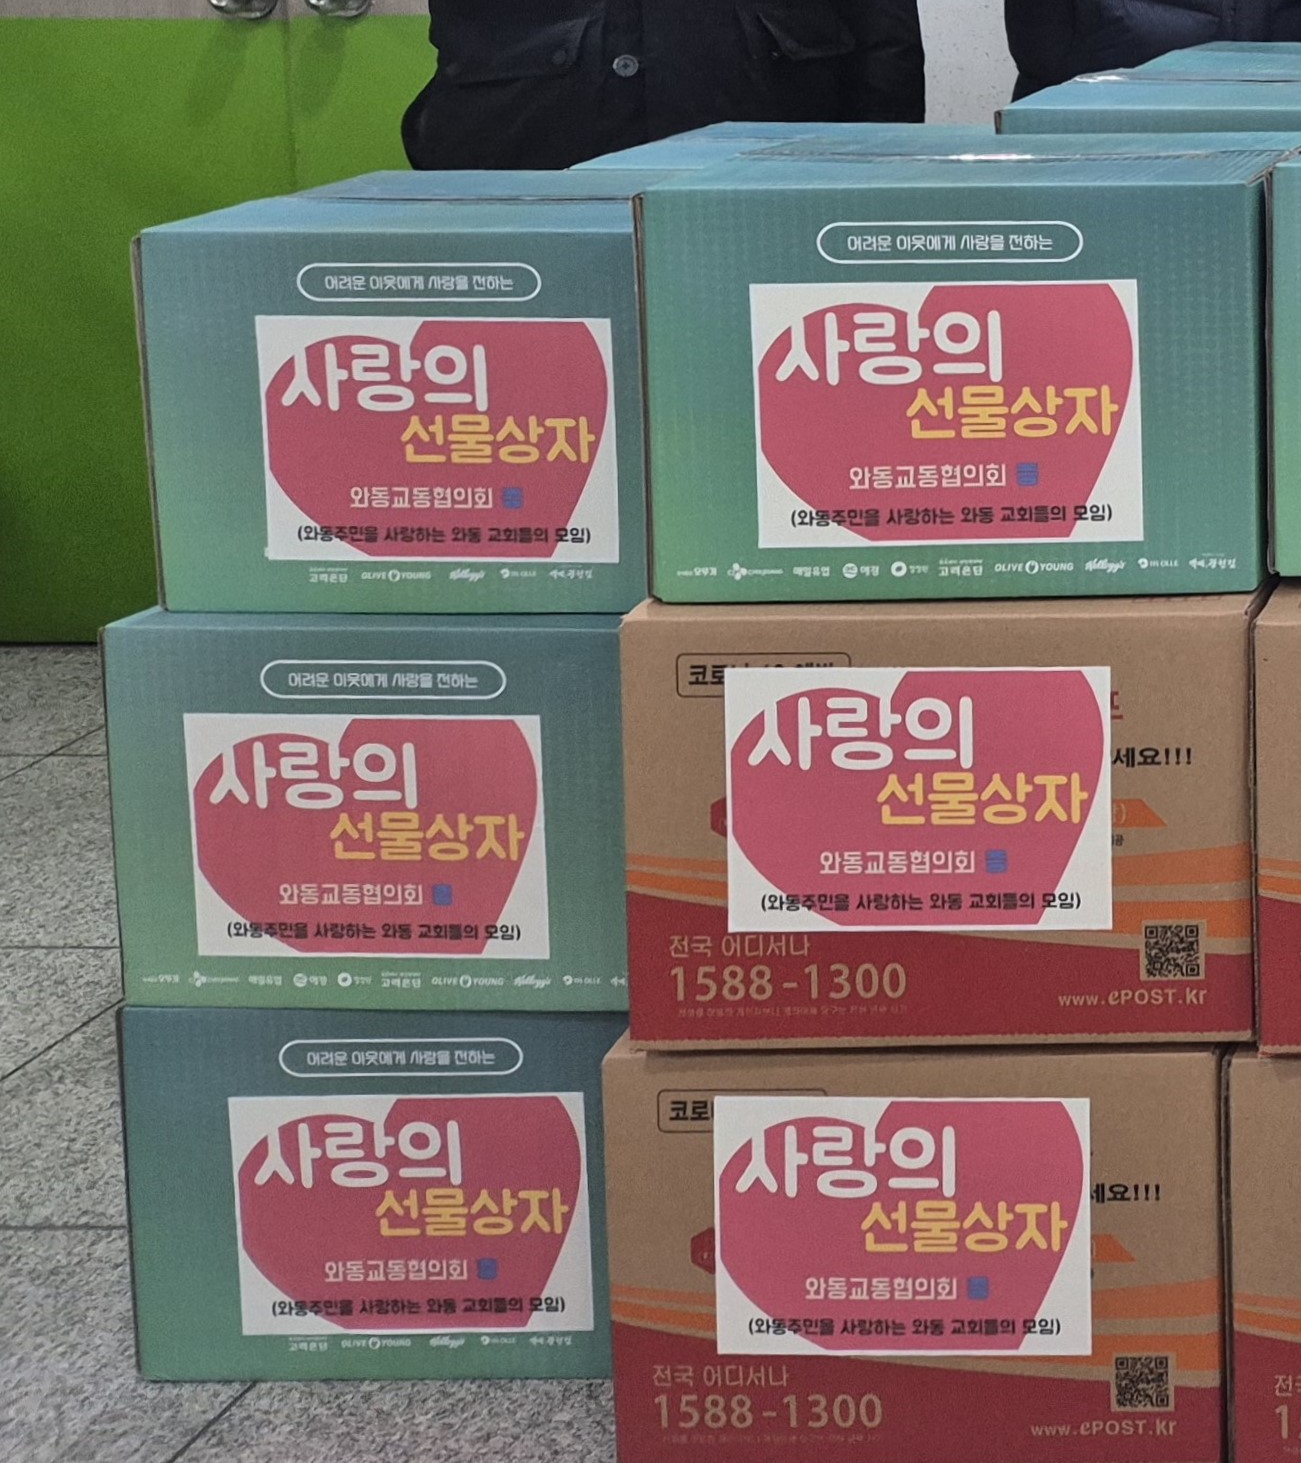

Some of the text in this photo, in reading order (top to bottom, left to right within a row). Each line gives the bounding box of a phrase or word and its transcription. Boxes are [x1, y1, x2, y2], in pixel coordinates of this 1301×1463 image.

[847, 234, 1053, 251] 어려운 이웃에게 사랑을 전하는
[776, 310, 1002, 385] 사랑의
[282, 342, 487, 412] 사랑의
[907, 385, 1118, 438] 선물상자
[401, 414, 595, 464] 선물상자
[351, 487, 492, 508] 와동교동협의회
[850, 463, 1006, 489] 와동교동협의회
[791, 503, 1112, 528] (와동주민을 사랑하는 와동 교회들의 모임)
[994, 562, 1074, 572] OLIVE YOUNG
[749, 696, 972, 770] 사랑의
[210, 740, 417, 810] 사랑의
[877, 771, 1088, 825] 선물상자
[330, 811, 525, 861] 선물상자
[821, 850, 974, 874] 와동교동협의회
[280, 884, 422, 905] 와동교동협의회
[670, 963, 907, 1002] 1588-1300
[1057, 988, 1209, 1006] www.ePOST.kr
[256, 1120, 461, 1188] 사랑의
[736, 1126, 954, 1198] 사랑의
[375, 1188, 568, 1236] 선물상자
[861, 1200, 1068, 1252] 선물상자
[325, 1259, 467, 1281] 와동교동협의회
[806, 1277, 956, 1299] 와동교동협의회
[654, 1393, 882, 1429] 1588-1300
